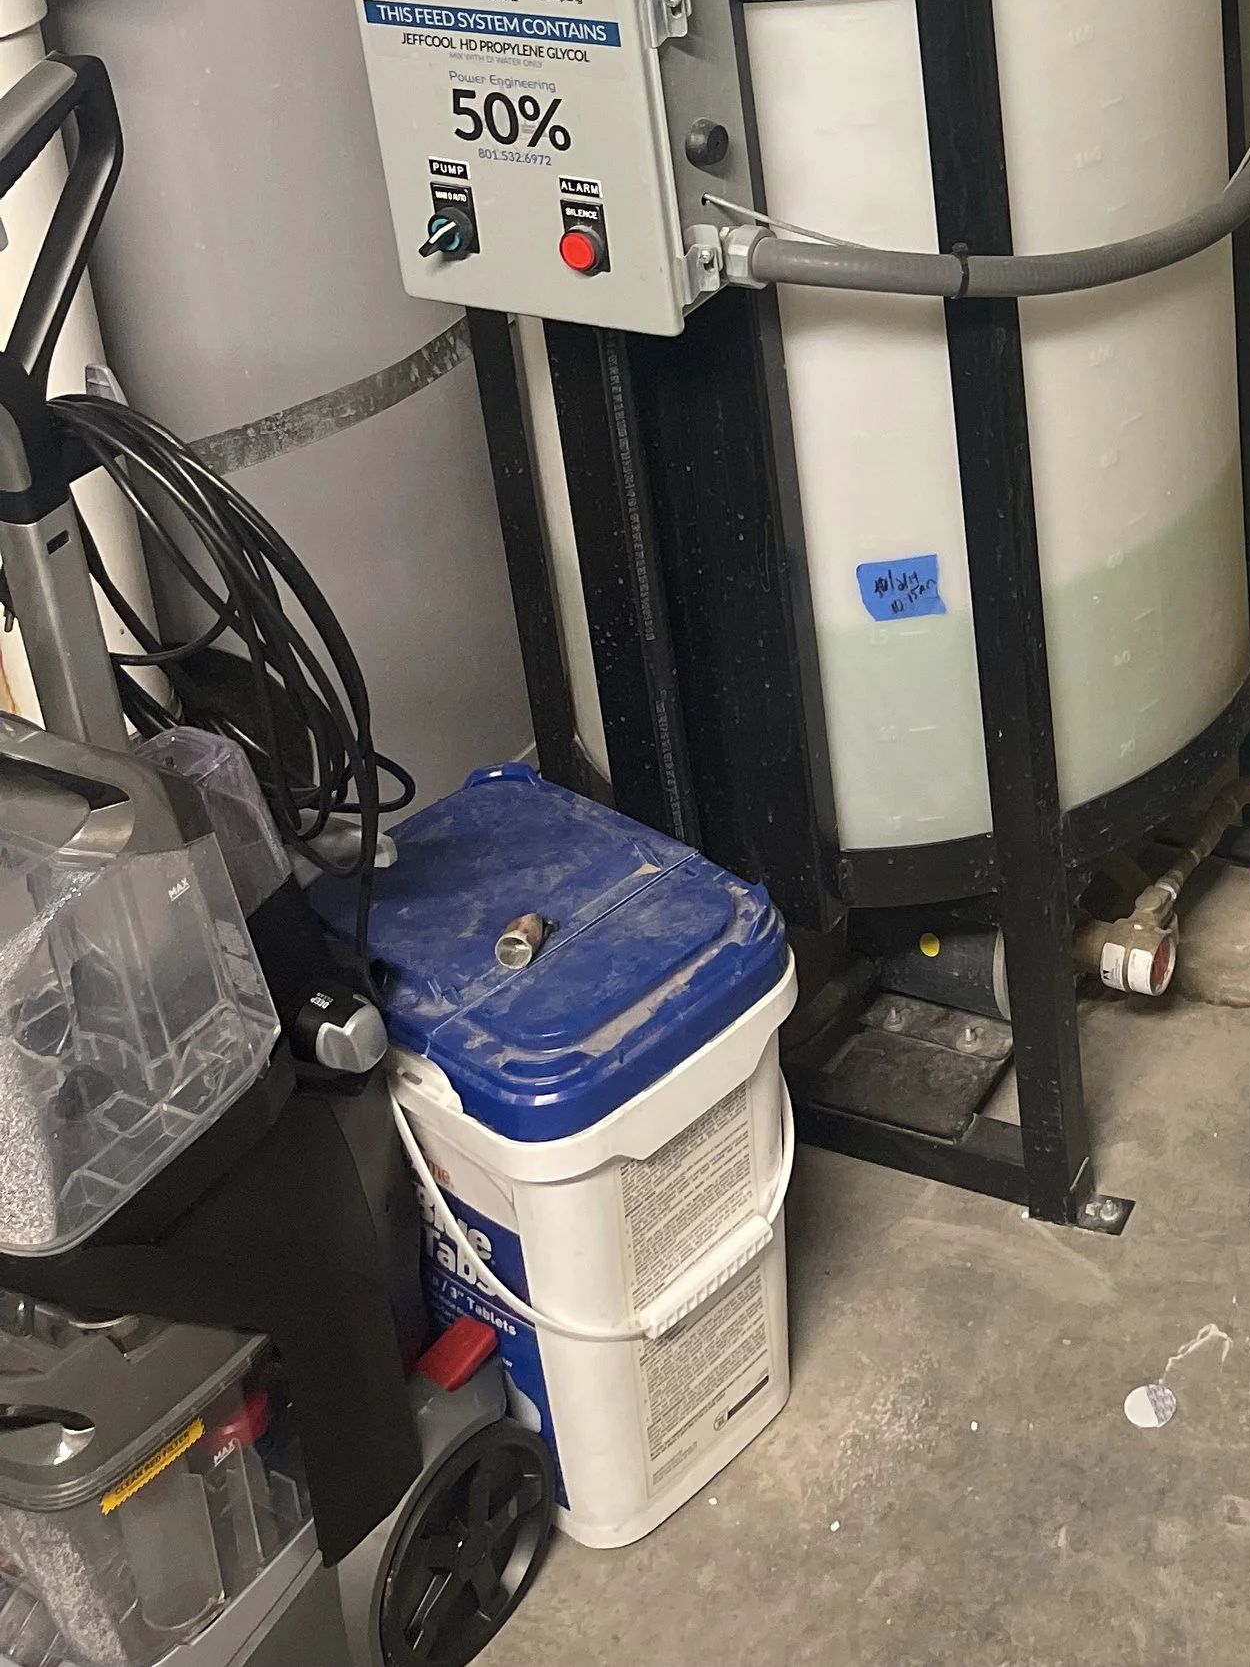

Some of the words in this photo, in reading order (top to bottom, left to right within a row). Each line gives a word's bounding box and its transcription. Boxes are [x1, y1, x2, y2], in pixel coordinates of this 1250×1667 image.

[376, 4, 412, 22] THIS
[415, 8, 454, 27] FEED
[459, 12, 519, 33] SYSTEM
[522, 18, 607, 41] CONTAINS
[401, 32, 456, 50] JEFFCOOL
[460, 37, 477, 51] HD
[480, 40, 544, 58] PROPYLENE
[547, 45, 590, 62] GLYCOL
[464, 53, 484, 62] WITH
[495, 56, 522, 67] WATER
[523, 59, 543, 68] ONLY
[449, 71, 486, 85] Power
[489, 74, 556, 93] Engineering
[452, 88, 571, 151] 50%
[478, 148, 552, 166] 801.532.6972
[432, 163, 464, 176] PUMP
[453, 193, 467, 202] AUTO
[561, 180, 599, 195] ALARM
[565, 207, 598, 220] SILENCE
[168, 877, 189, 900] MAX
[467, 1296, 517, 1336] Tablets
[213, 1437, 235, 1464] MAX
